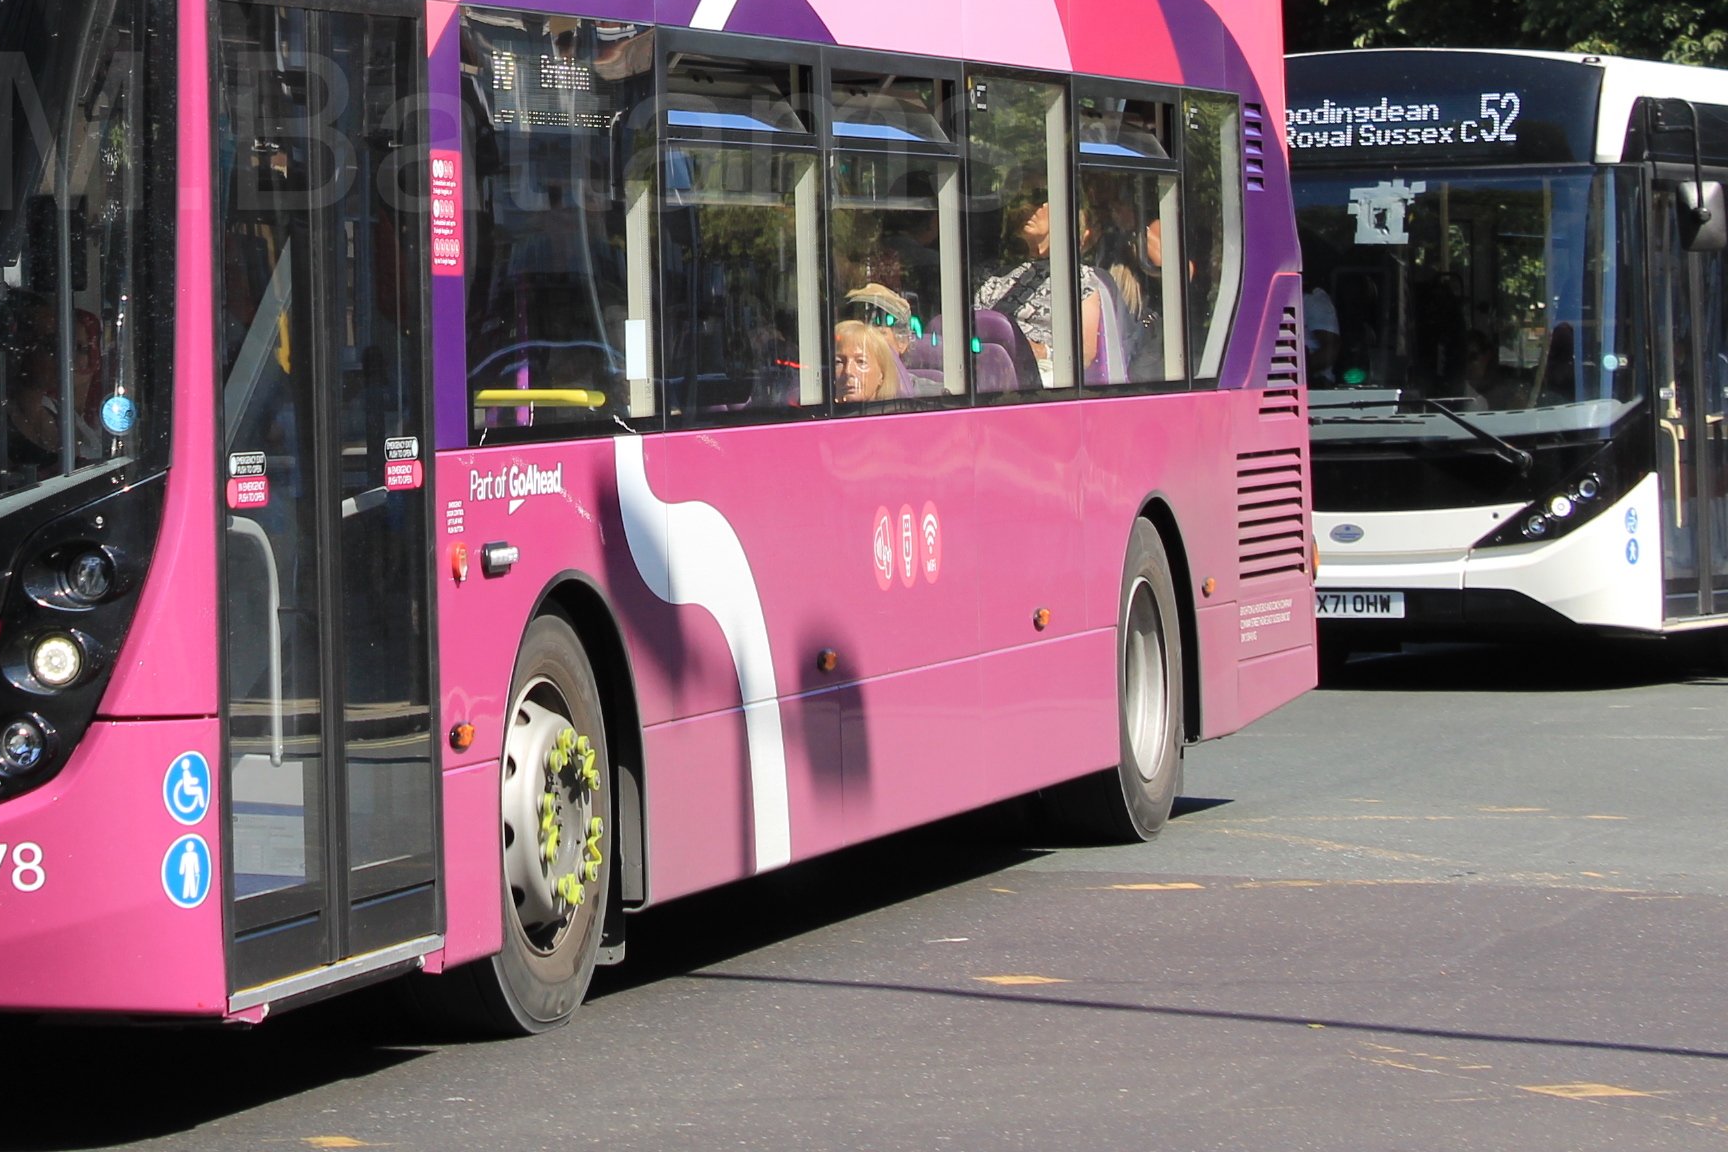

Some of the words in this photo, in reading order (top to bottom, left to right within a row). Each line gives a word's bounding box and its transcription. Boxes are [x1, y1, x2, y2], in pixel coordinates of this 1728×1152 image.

[1285, 97, 1440, 125] oodingdean
[1480, 91, 1521, 142] 52
[1286, 124, 1352, 148] Royal
[1359, 123, 1454, 146] Sussex
[469, 470, 493, 501] Part
[495, 467, 507, 498] of
[509, 462, 562, 497] GoAhead
[1316, 594, 1346, 613] X71
[1353, 594, 1391, 613] OHW
